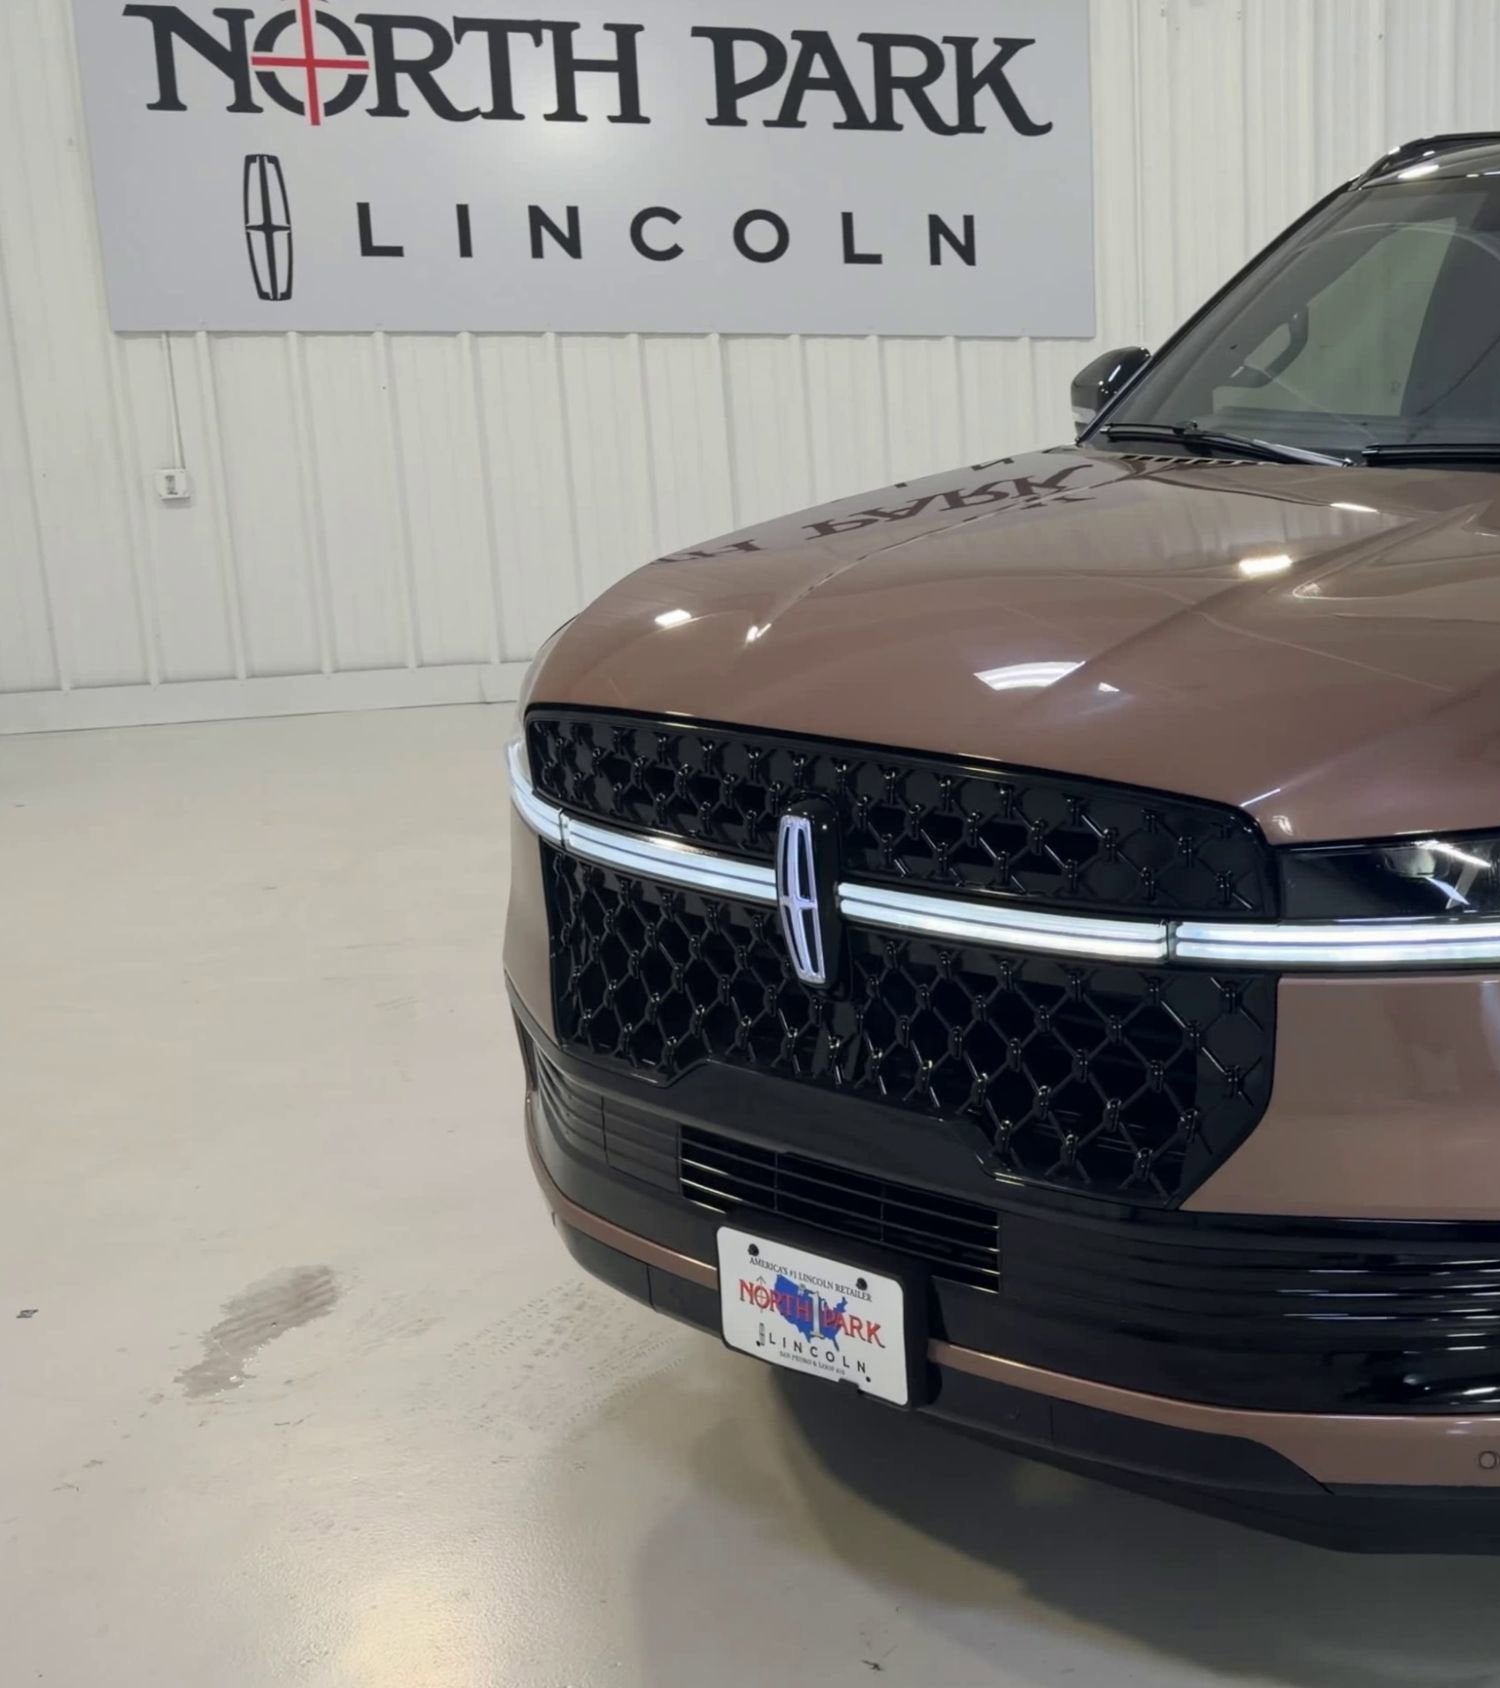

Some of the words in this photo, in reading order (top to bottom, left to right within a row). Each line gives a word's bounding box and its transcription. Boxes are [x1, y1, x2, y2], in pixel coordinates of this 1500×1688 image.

[121, 2, 651, 125] NORTH
[691, 24, 1053, 137] PARK
[356, 202, 977, 266] LINCOLN
[739, 1278, 811, 1322] NORTH
[823, 1304, 886, 1350] PARK
[798, 1272, 834, 1290] LINCOLN
[835, 1283, 873, 1302] RETAILER
[769, 1332, 866, 1374] LINCOLN
